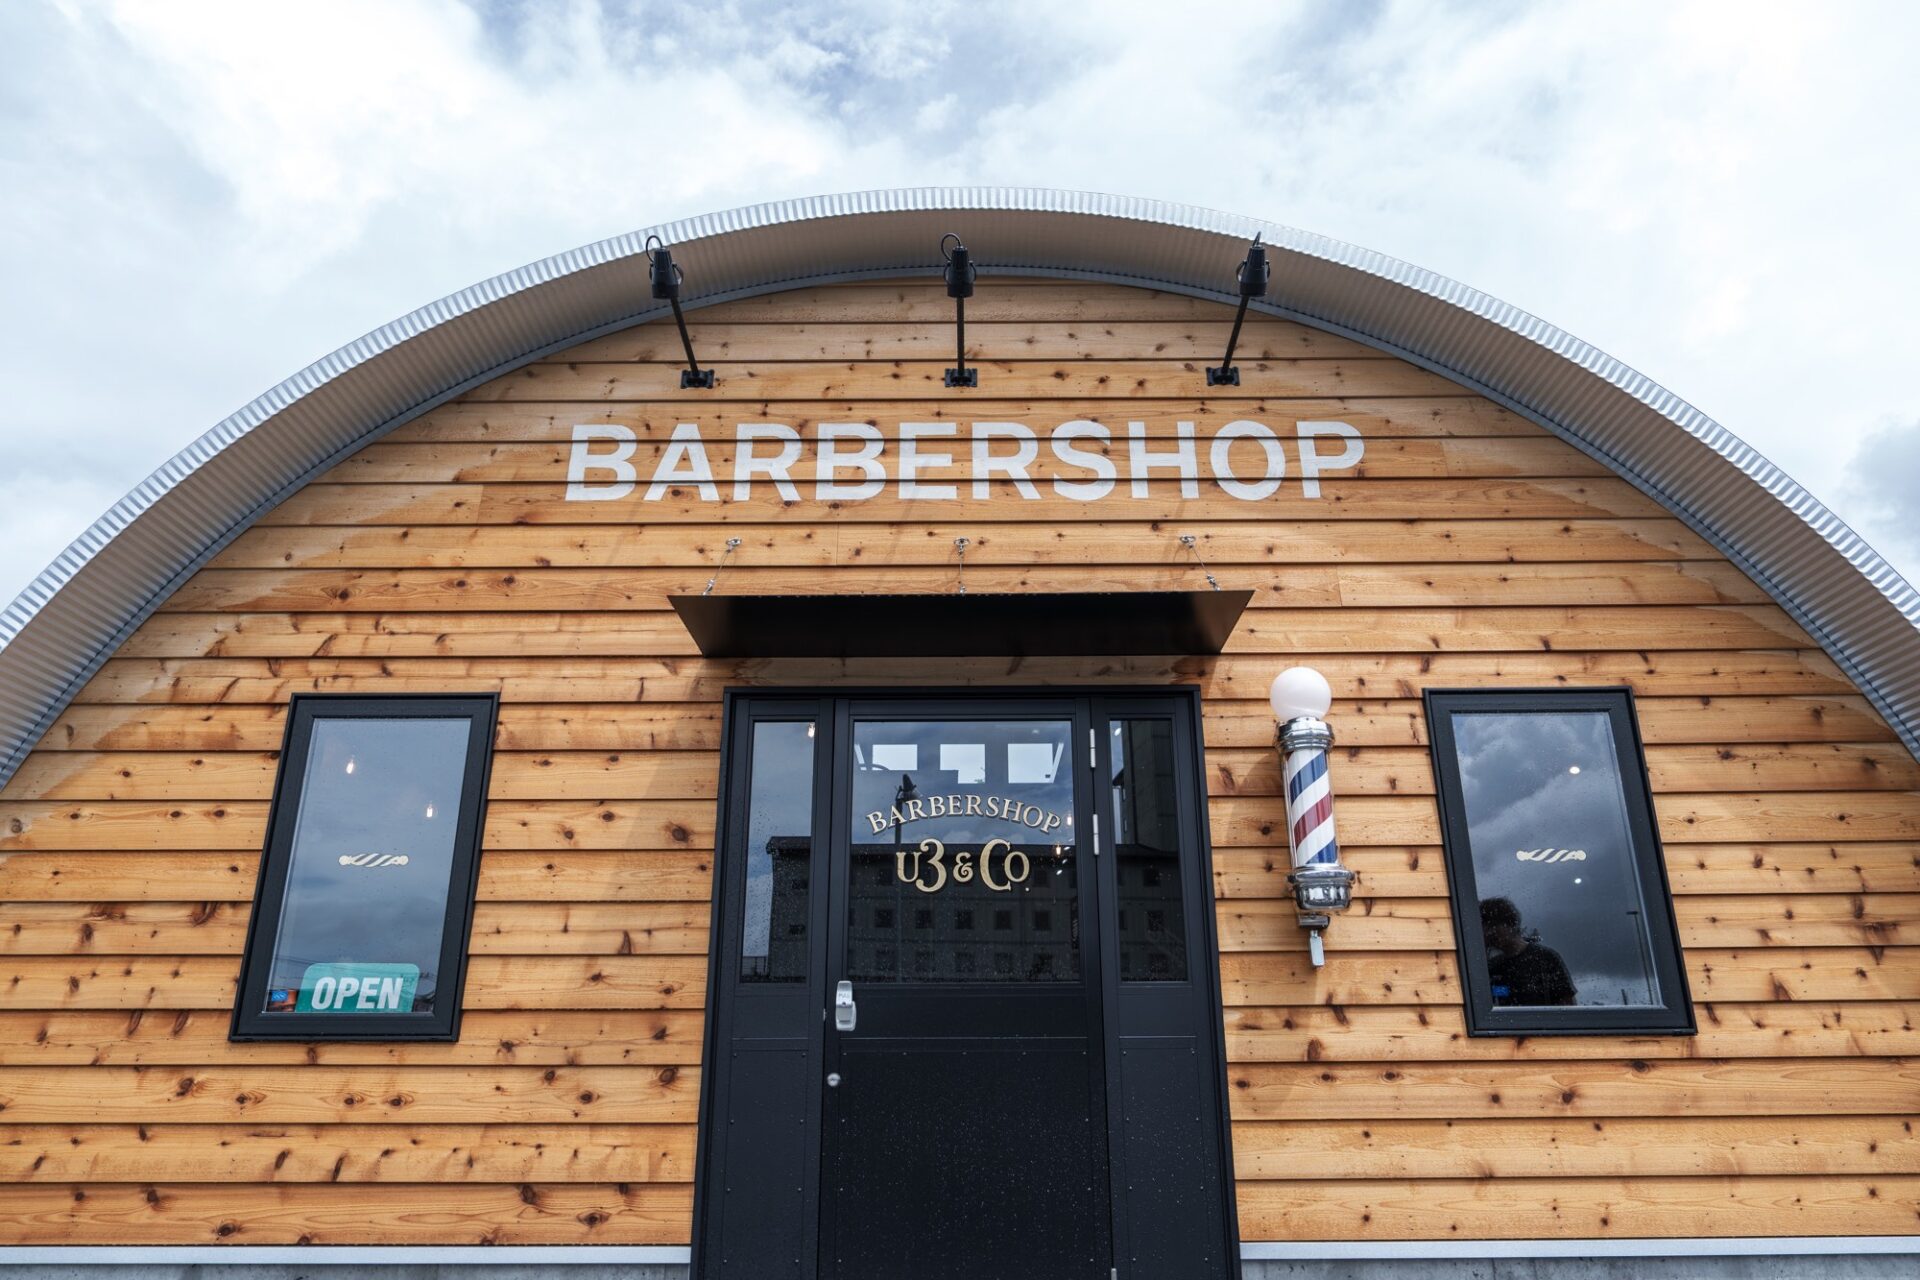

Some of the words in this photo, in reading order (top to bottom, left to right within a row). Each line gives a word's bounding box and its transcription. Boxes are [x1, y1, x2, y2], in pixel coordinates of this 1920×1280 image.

[565, 419, 1365, 502] BARBERSHOP
[866, 794, 1061, 834] BARBERSHOP
[953, 852, 974, 883] &
[311, 976, 404, 1010] OPEN
